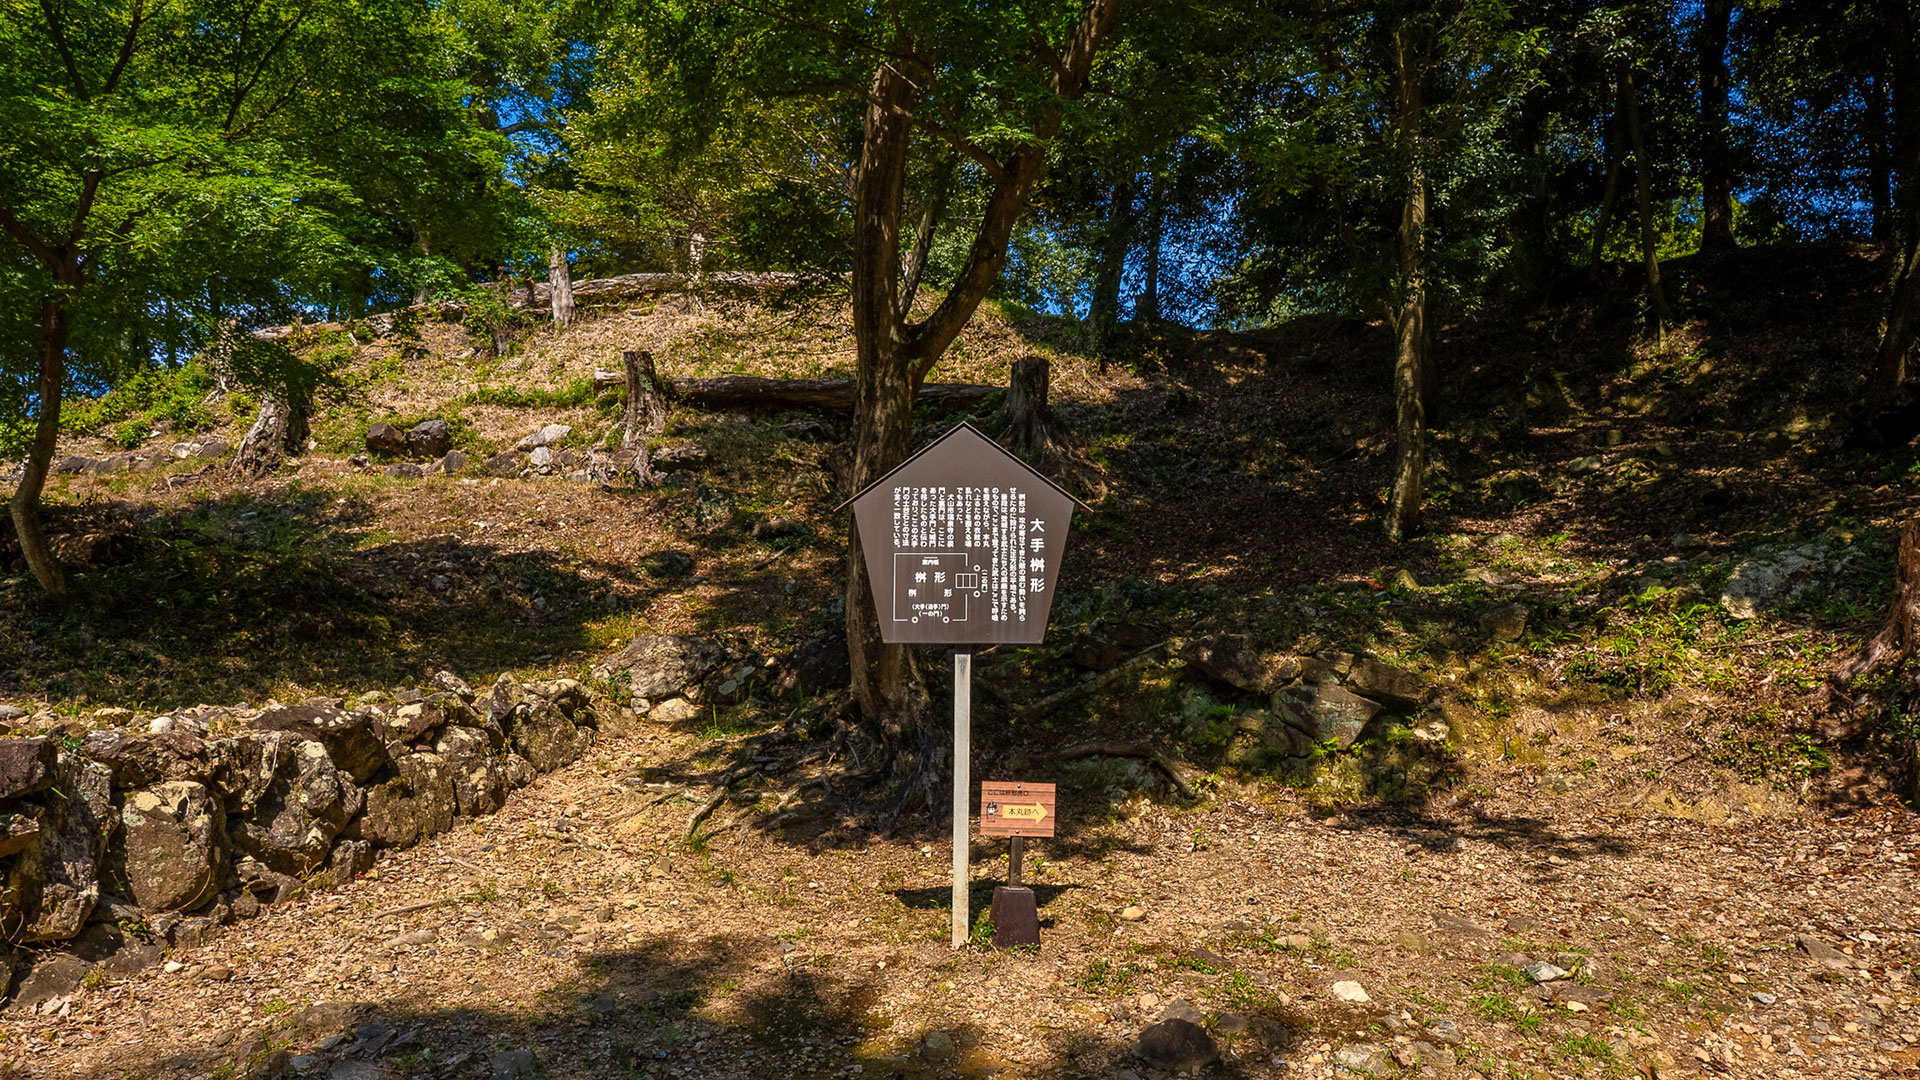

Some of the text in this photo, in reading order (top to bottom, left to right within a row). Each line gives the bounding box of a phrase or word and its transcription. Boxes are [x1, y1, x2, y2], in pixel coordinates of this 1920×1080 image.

[1030, 518, 1045, 592] 大手桝形
[1008, 808, 1040, 816] 本丸跡へ
